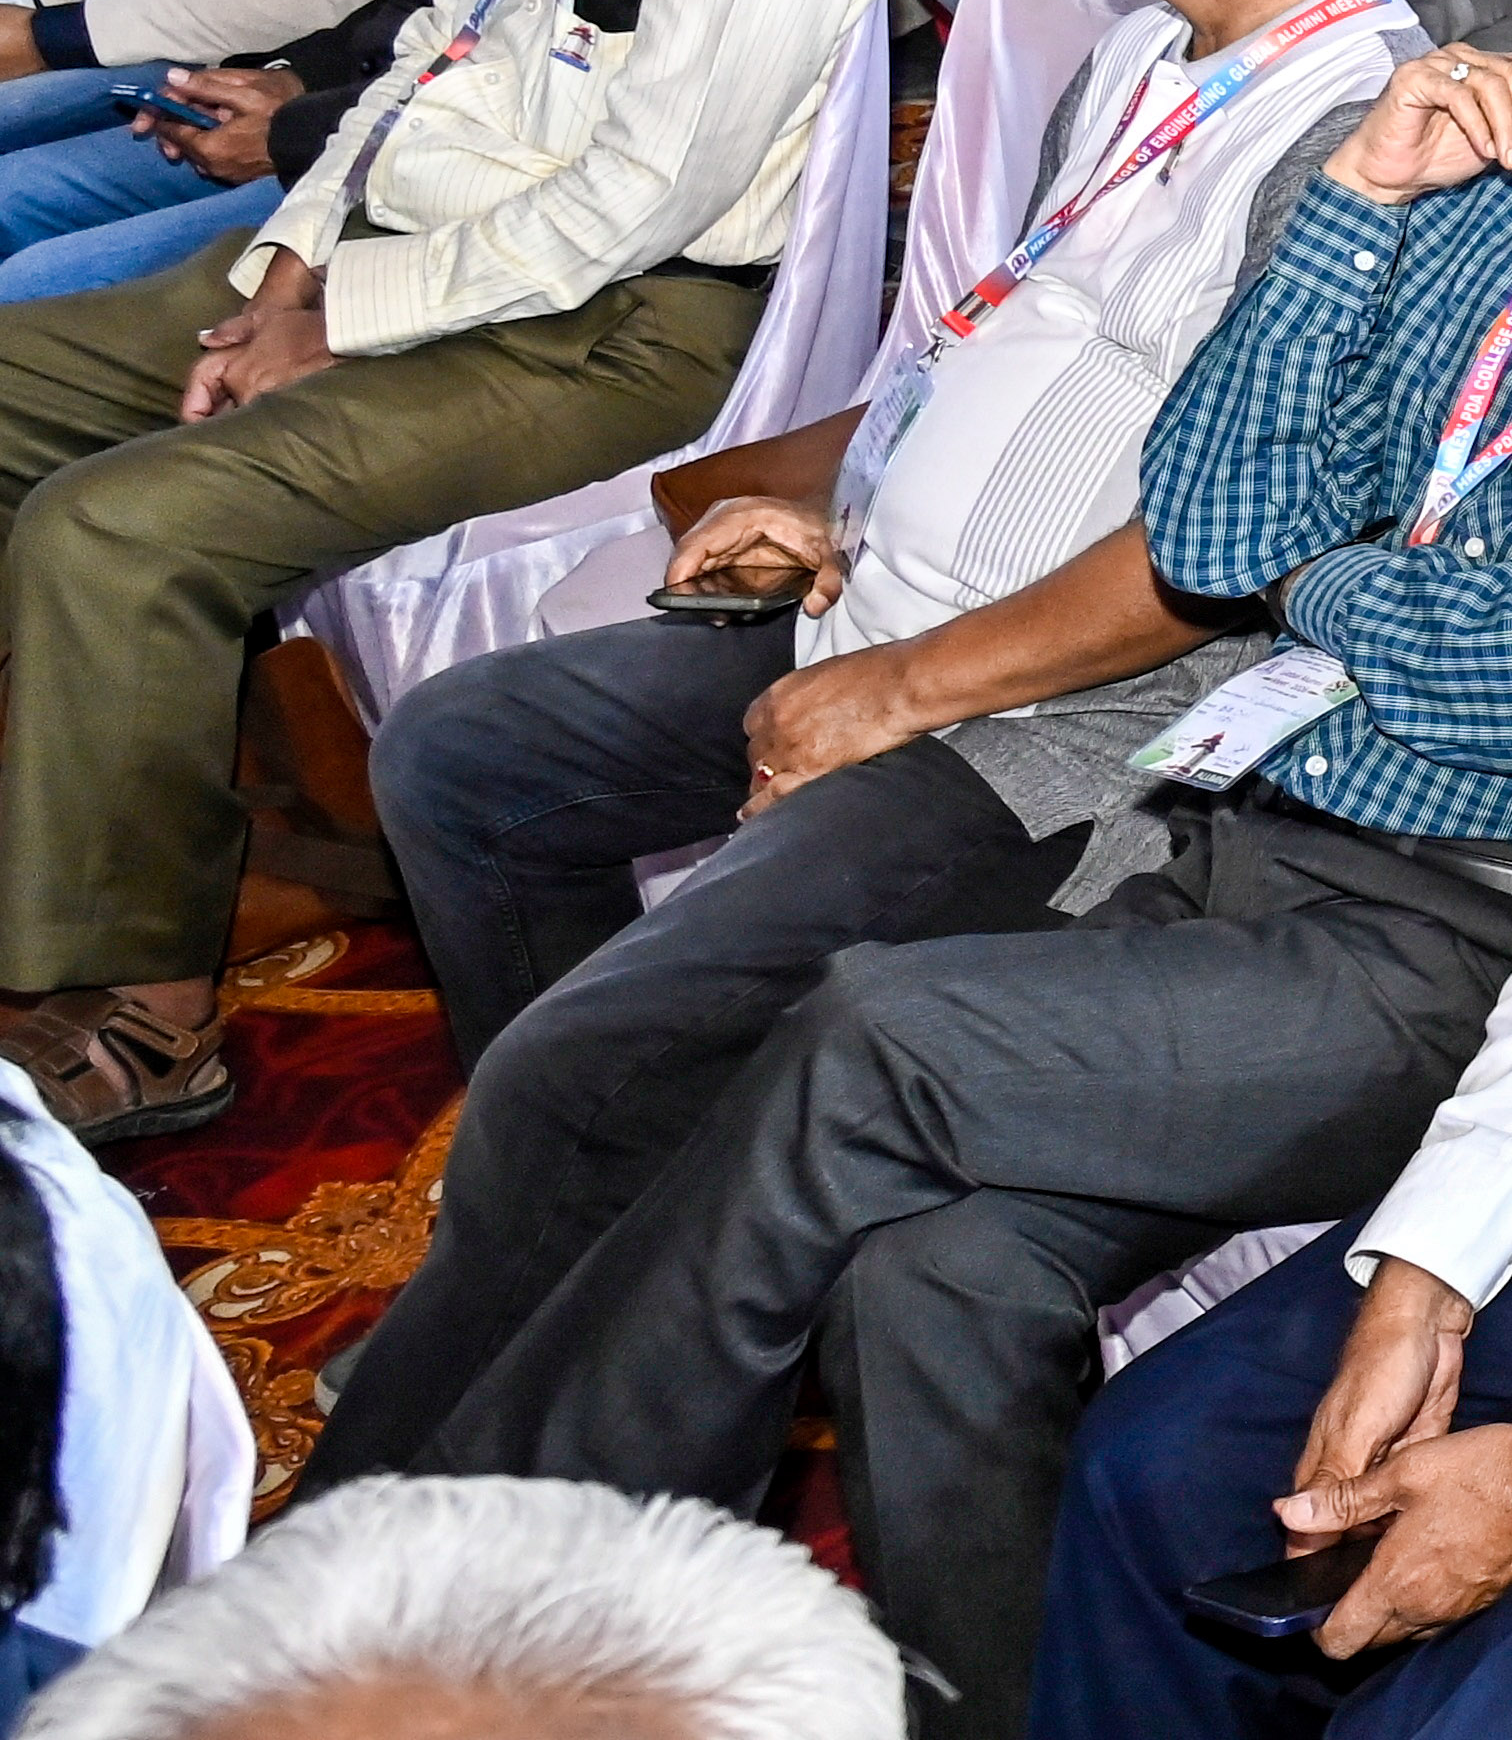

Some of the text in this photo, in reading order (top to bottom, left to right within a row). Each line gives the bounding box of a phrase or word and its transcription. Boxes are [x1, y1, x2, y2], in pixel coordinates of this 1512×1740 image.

[1134, 145, 1153, 166] OF
[1151, 81, 1228, 149] ENGINEERING
[1232, 36, 1278, 83] GLOBAL
[1277, 6, 1328, 48] ALUMNI
[1461, 394, 1484, 424] PDA
[1455, 448, 1492, 491] HKES'
